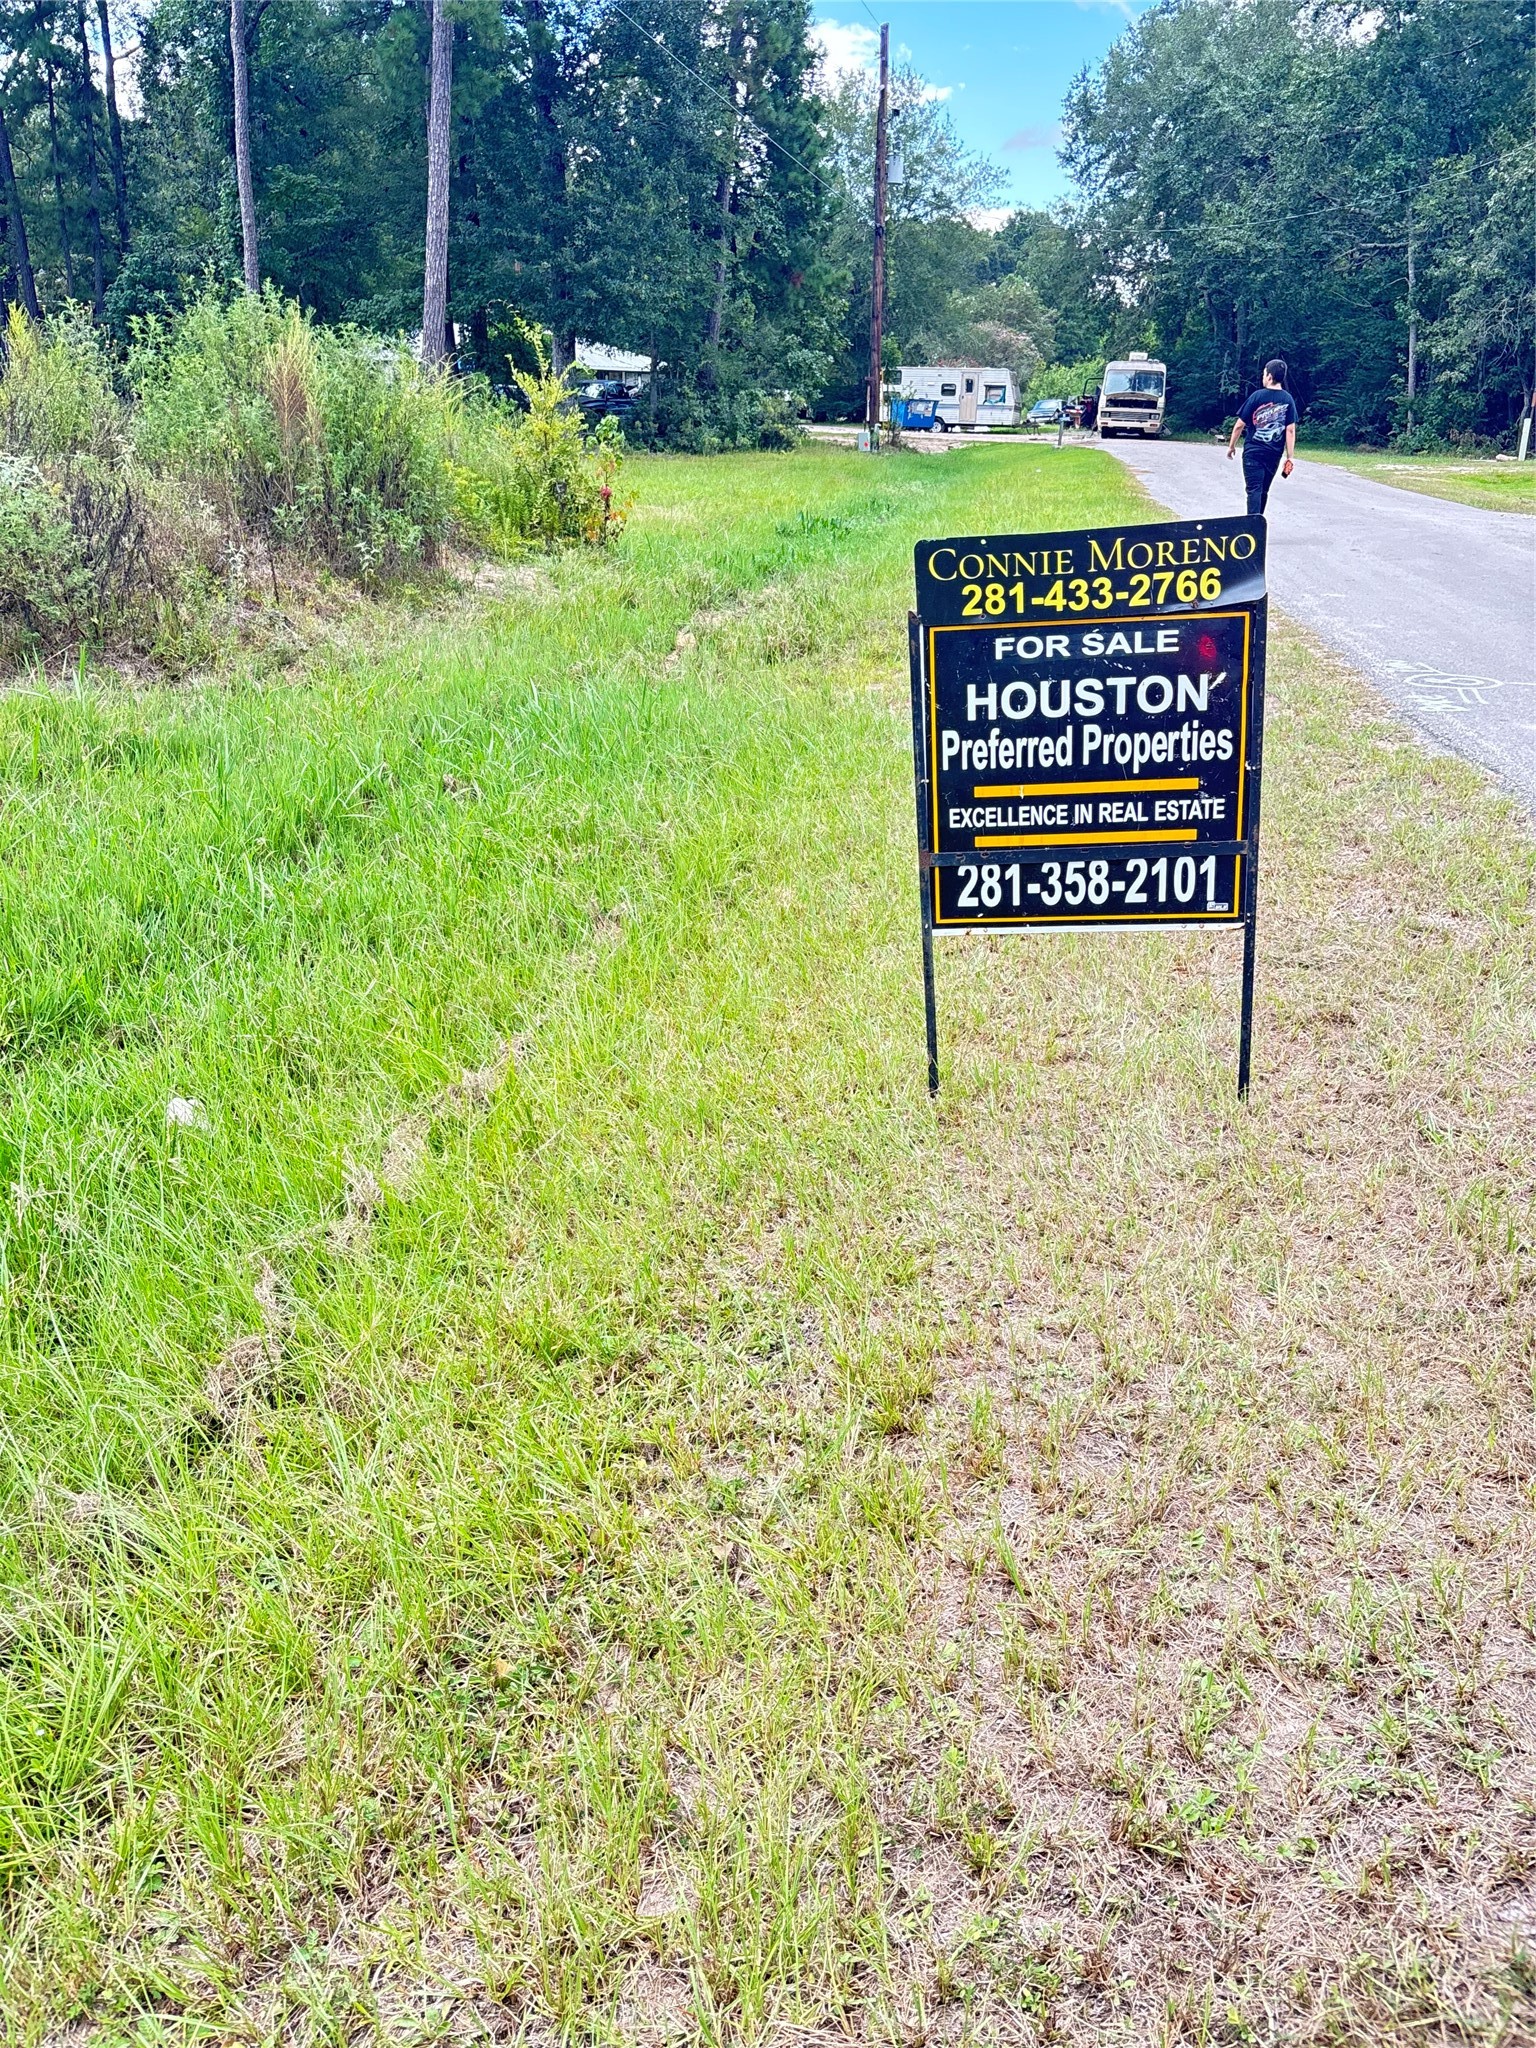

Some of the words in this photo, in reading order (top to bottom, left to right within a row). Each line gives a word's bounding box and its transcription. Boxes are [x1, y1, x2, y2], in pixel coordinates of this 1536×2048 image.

[928, 547, 1074, 582] CONNIE
[1087, 532, 1257, 573] MORENO
[961, 567, 1222, 616] 281-433-2766
[994, 635, 1070, 660] FOR
[1081, 629, 1180, 656] SALE
[966, 673, 1209, 721] HOUSTON
[942, 725, 1073, 771] Preferred
[1082, 720, 1233, 774] Properties
[949, 804, 1068, 829] EXCELLENCE
[1074, 803, 1092, 825] IN
[1098, 802, 1149, 823] REAL
[1154, 798, 1225, 821] ESTATE
[957, 855, 1216, 907] 281-358-2101
